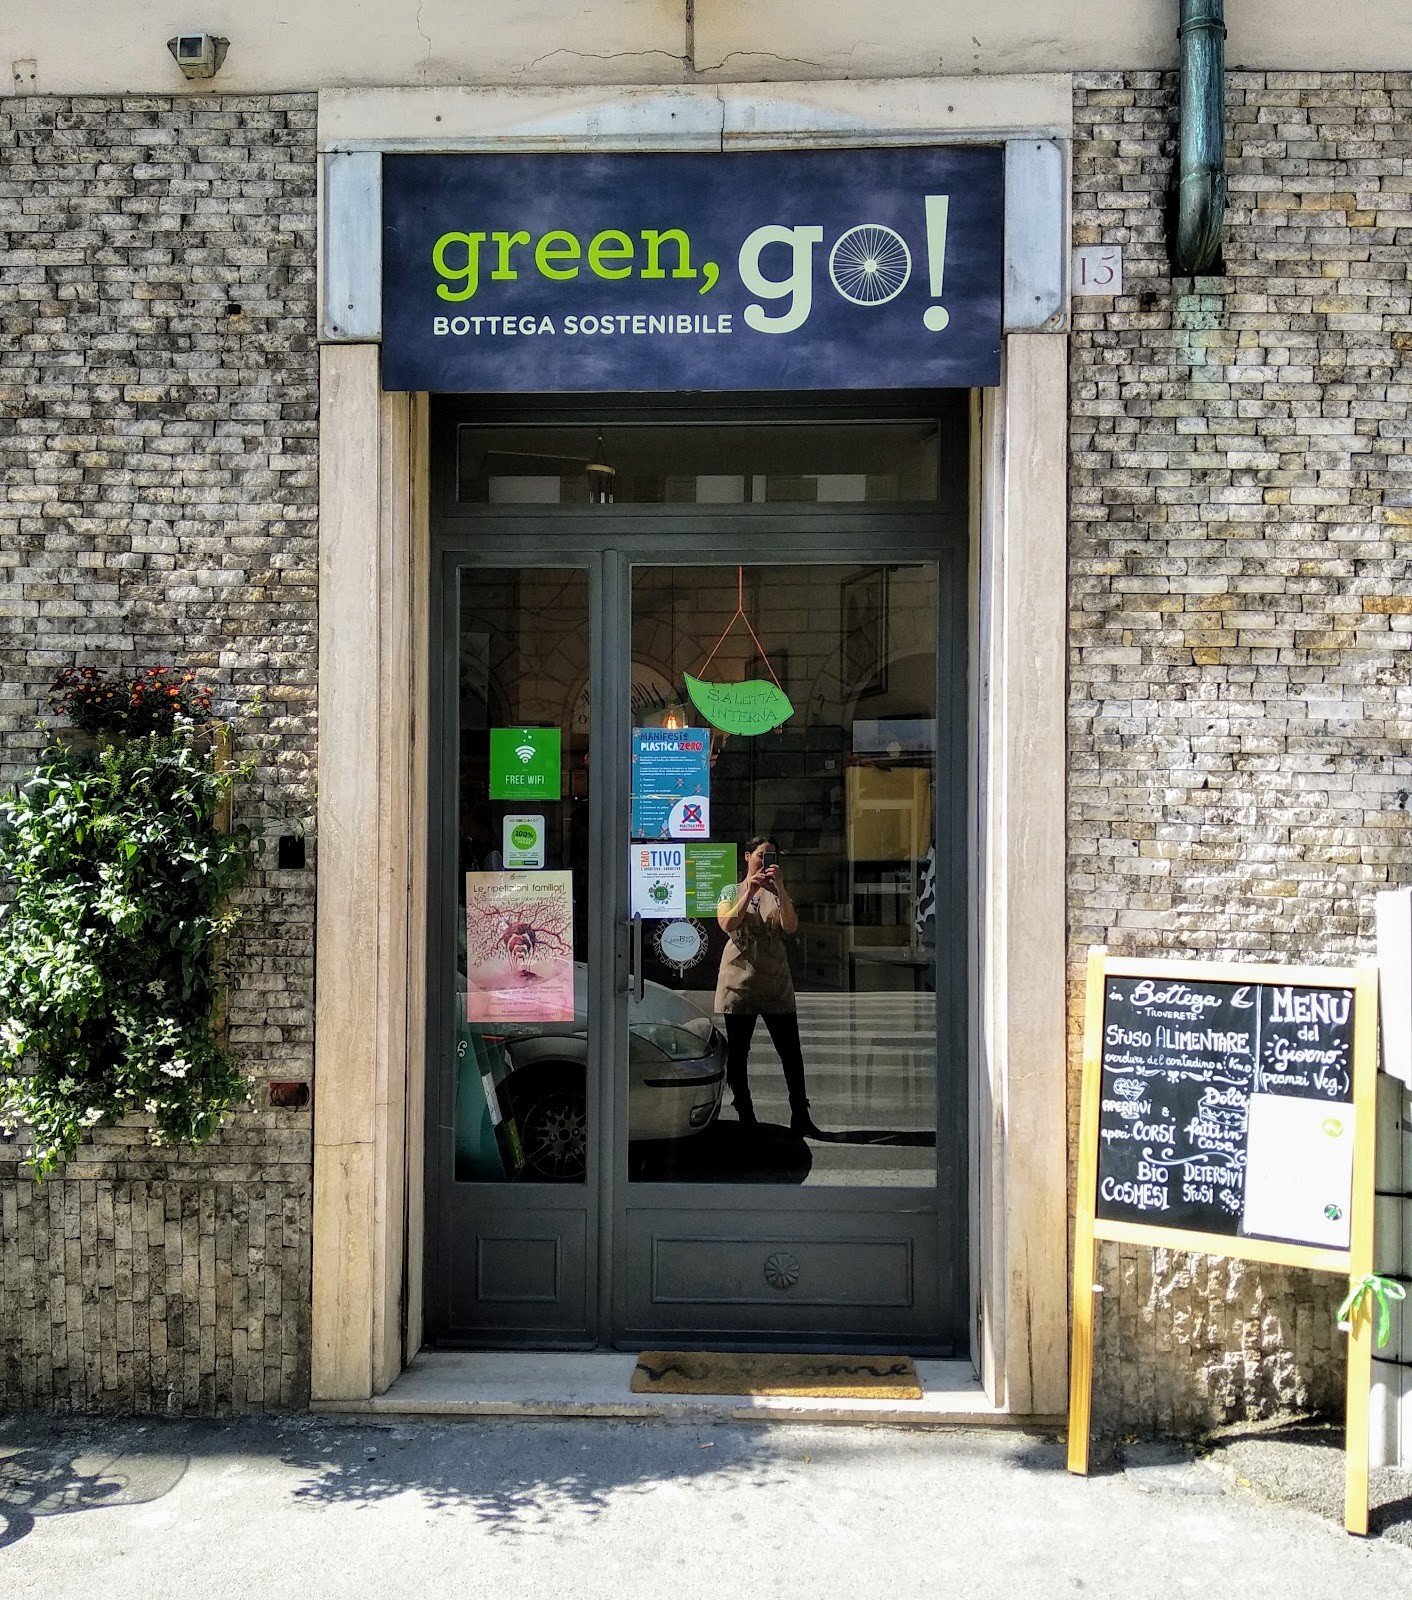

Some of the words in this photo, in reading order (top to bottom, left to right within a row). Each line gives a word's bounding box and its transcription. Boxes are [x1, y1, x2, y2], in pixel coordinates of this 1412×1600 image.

[432, 228, 720, 303] green,
[1080, 254, 1116, 286] 15
[433, 315, 556, 336] BOTTEGA
[563, 314, 733, 335] SOSTENIBILE
[707, 688, 780, 705] SALETTA
[710, 704, 778, 723] INTERNA
[505, 774, 525, 785] FREE
[527, 774, 545, 785] WIFI
[515, 830, 534, 838] 100%
[650, 850, 681, 867] TIVO
[473, 884, 484, 893] Le
[1109, 986, 1124, 1001] in
[1129, 980, 1223, 1014] Bottega
[1269, 986, 1354, 1025] MENÙ
[1297, 1024, 1320, 1042] del
[1104, 1050, 1146, 1065] verdure
[1146, 1054, 1164, 1066] del
[1165, 1053, 1216, 1070] contadino
[1274, 1038, 1343, 1072] Giorno
[1161, 1106, 1170, 1117] &
